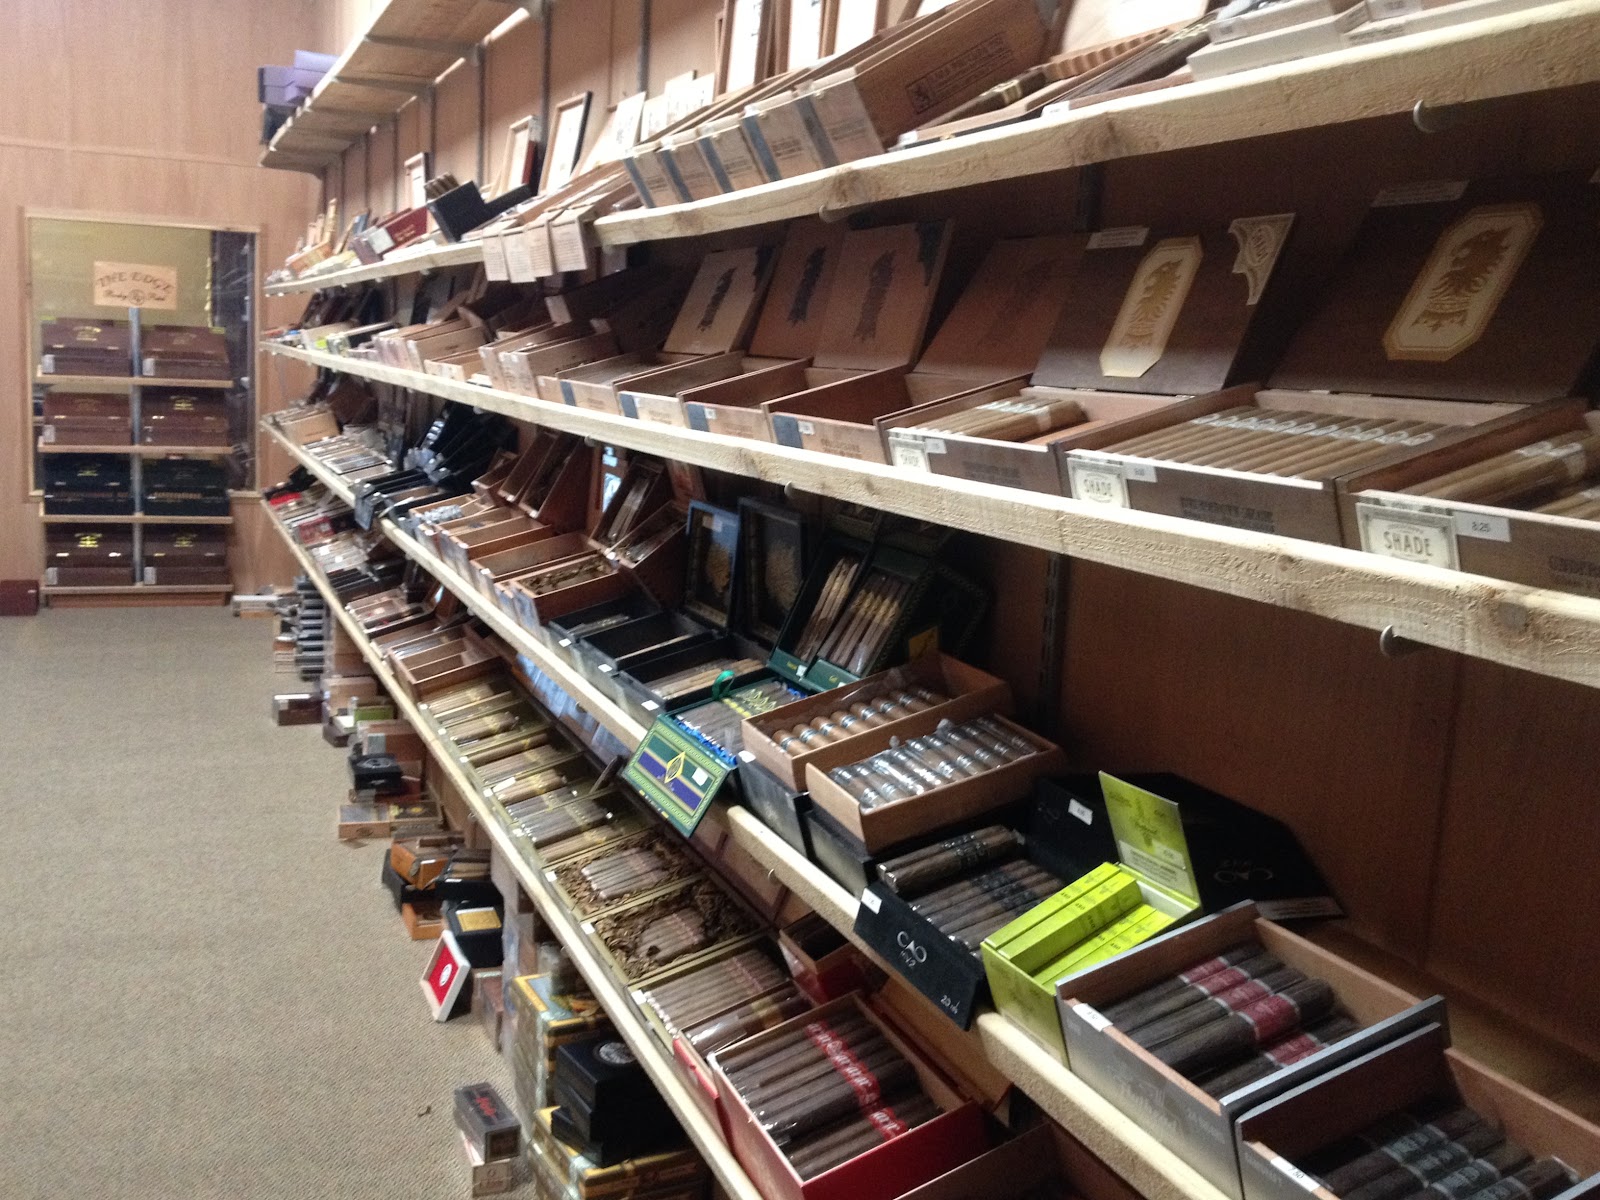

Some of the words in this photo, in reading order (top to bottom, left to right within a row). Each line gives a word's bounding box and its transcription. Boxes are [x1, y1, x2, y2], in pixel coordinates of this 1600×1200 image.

[1083, 478, 1113, 497] SHADE
[1383, 530, 1433, 557] SHADE
[897, 930, 928, 963] CAO
